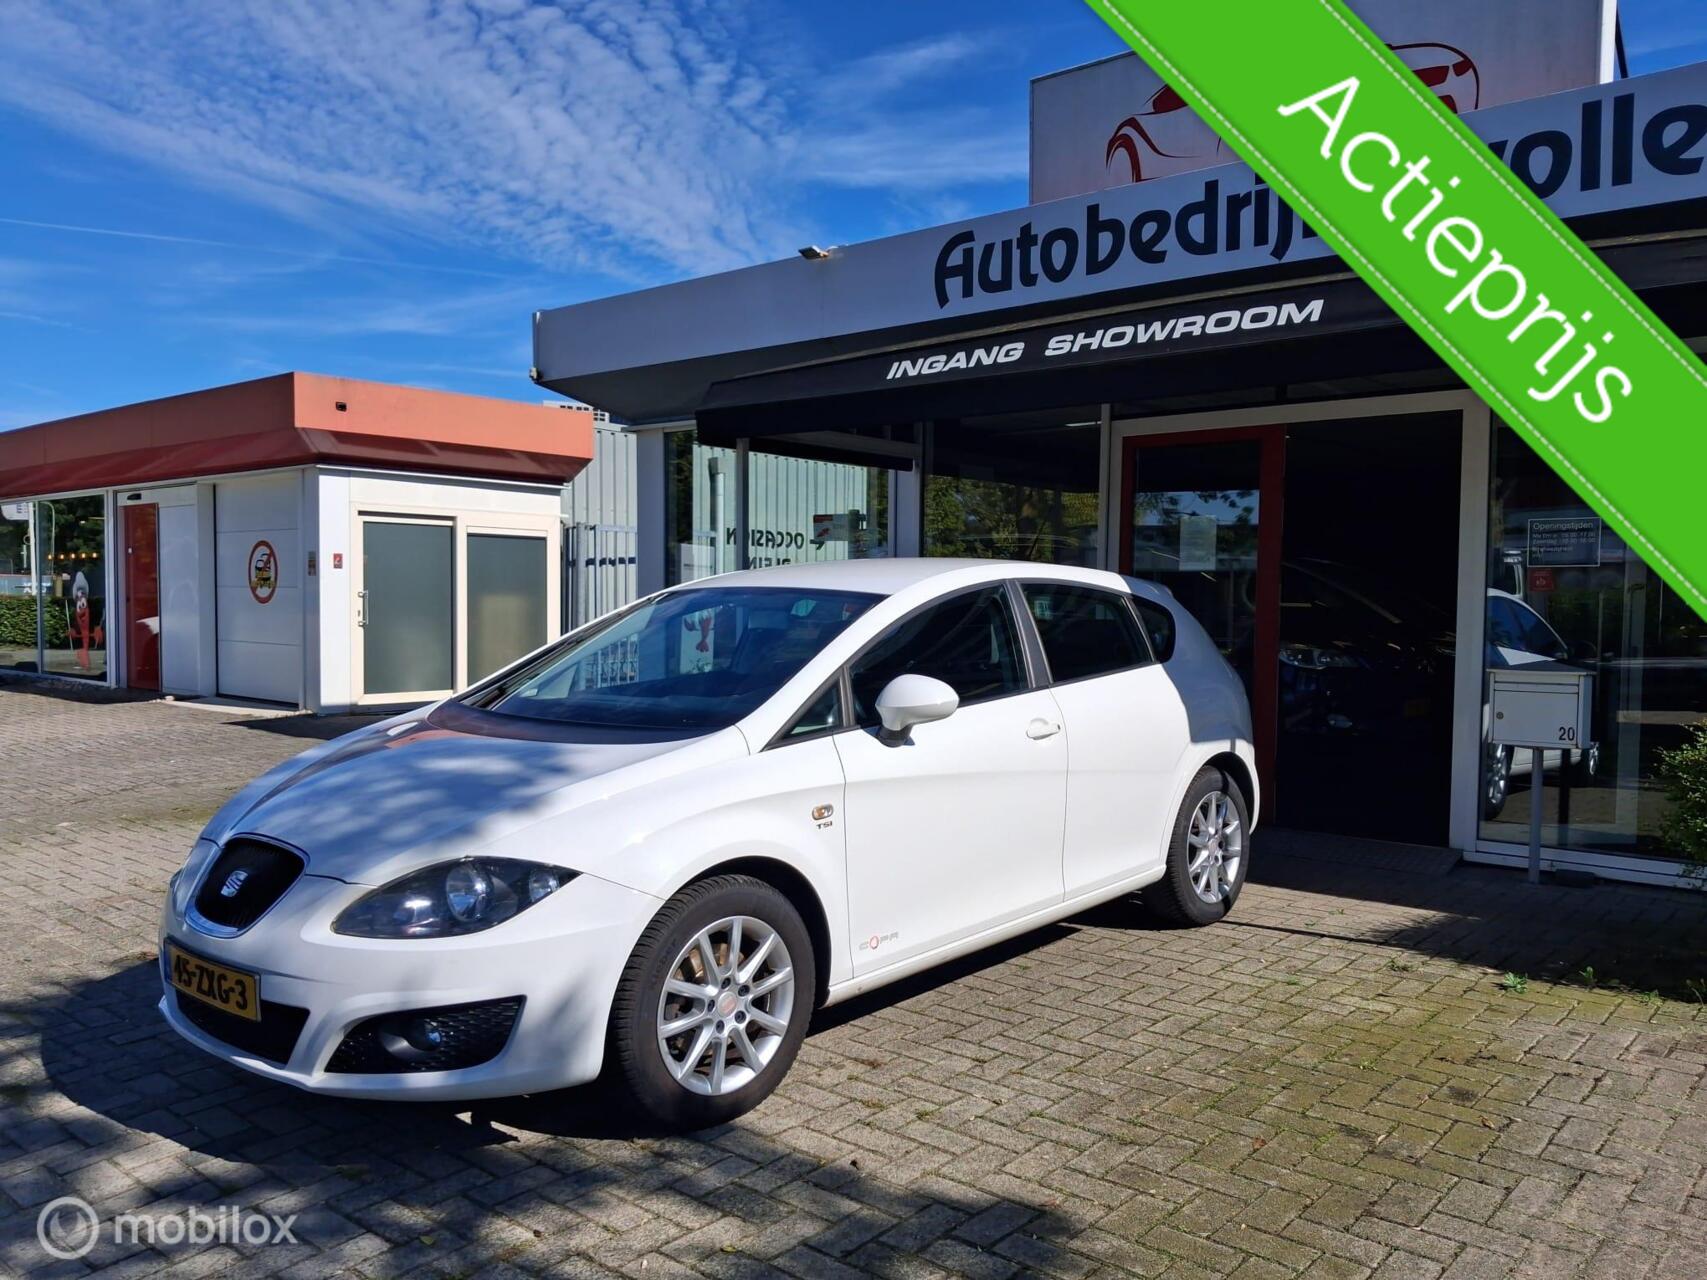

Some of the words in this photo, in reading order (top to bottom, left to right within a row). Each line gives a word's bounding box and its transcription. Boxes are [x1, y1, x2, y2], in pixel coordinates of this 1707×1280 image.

[934, 172, 1318, 308] Autobedrij
[1487, 93, 1707, 200] olle
[886, 342, 1025, 381] INGANG
[1044, 299, 1325, 357] SHOWROOM
[1558, 726, 1575, 741] 20
